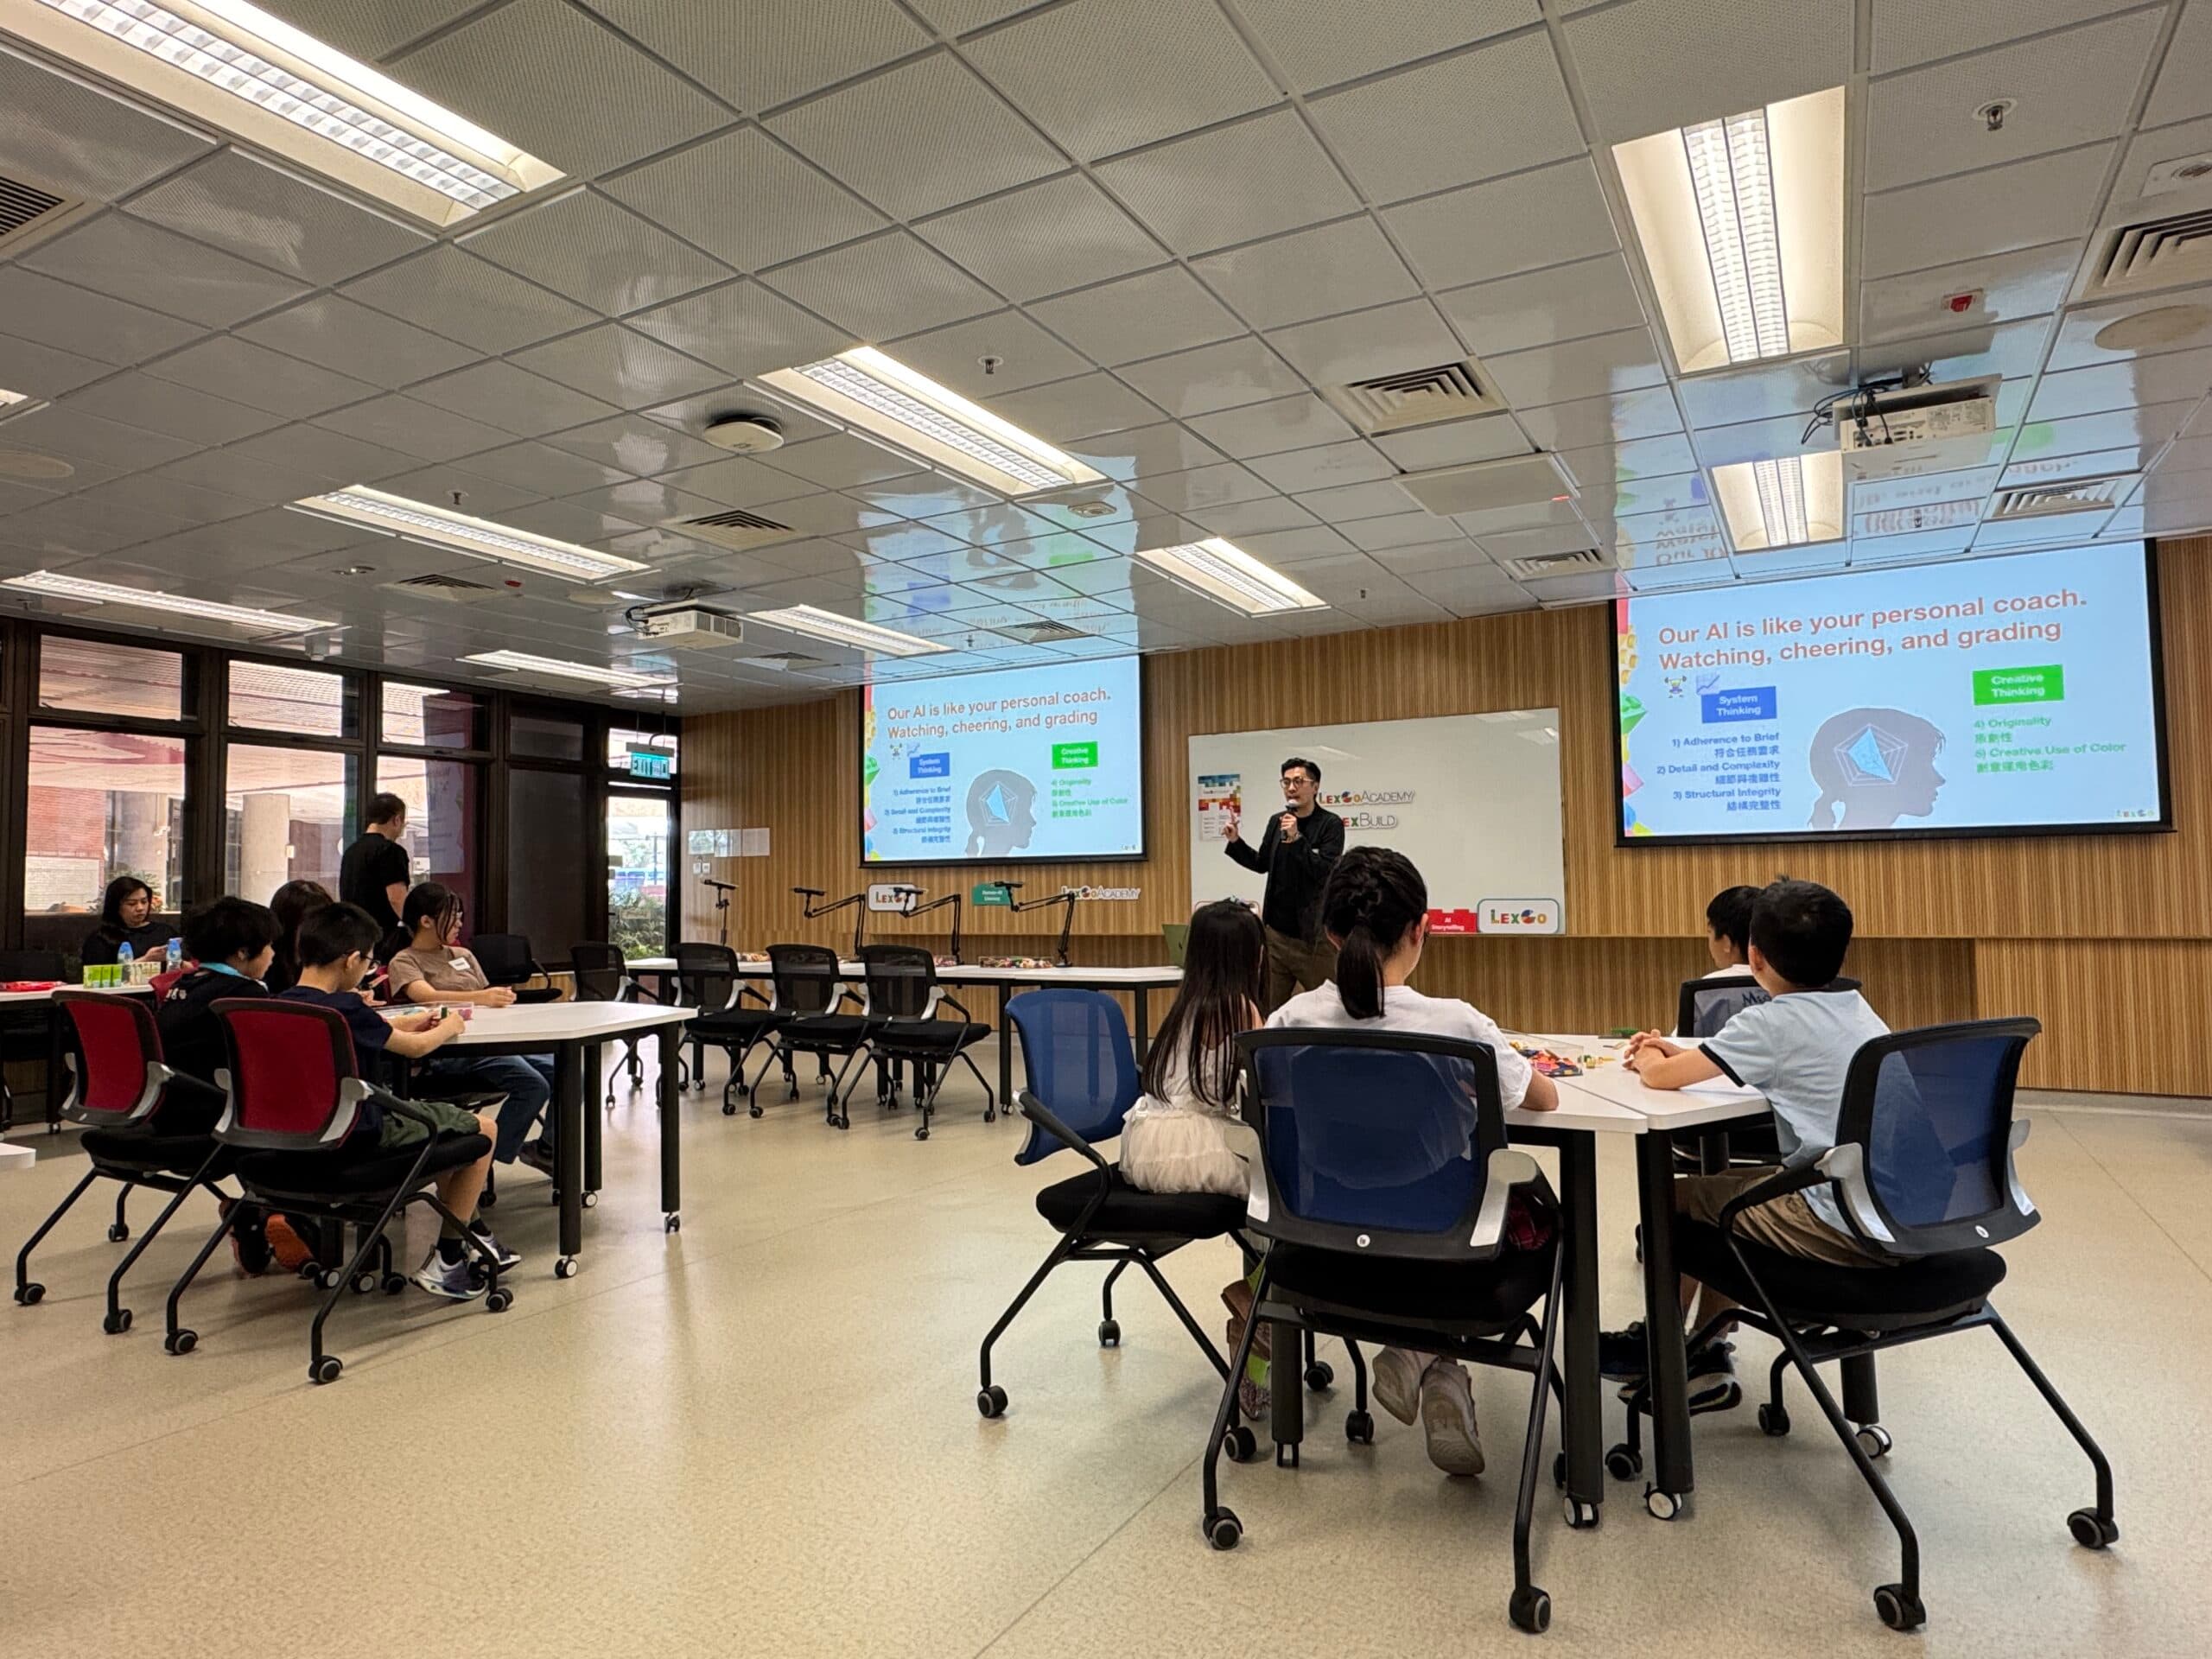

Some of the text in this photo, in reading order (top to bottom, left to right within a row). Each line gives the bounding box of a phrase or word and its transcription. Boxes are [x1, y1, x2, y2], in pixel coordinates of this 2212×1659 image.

[1659, 588, 2087, 644] Our AI is like your personal coach.
[1659, 620, 2062, 670] Watching, cheering, and grading
[1991, 674, 2044, 685] Creative
[1992, 686, 2045, 697] Thinking
[887, 687, 1111, 720] Our AI is like your personal coach.
[1719, 695, 1758, 705] System
[1716, 706, 1761, 716] Thinking
[887, 710, 1097, 739] Watching, cheering, and grading
[1988, 716, 2051, 728] Originality
[1683, 736, 1738, 747] Adherence
[1740, 734, 1751, 743] to
[1754, 732, 1779, 742] Brief
[1990, 747, 2041, 757] Creative
[2045, 745, 2070, 755] Use
[2074, 743, 2087, 753] of
[1669, 764, 1697, 773] Detail
[1700, 763, 1719, 772] and
[1722, 760, 1780, 771] Complexity
[1685, 789, 1735, 798] Structural
[1738, 787, 1781, 798] Integrity
